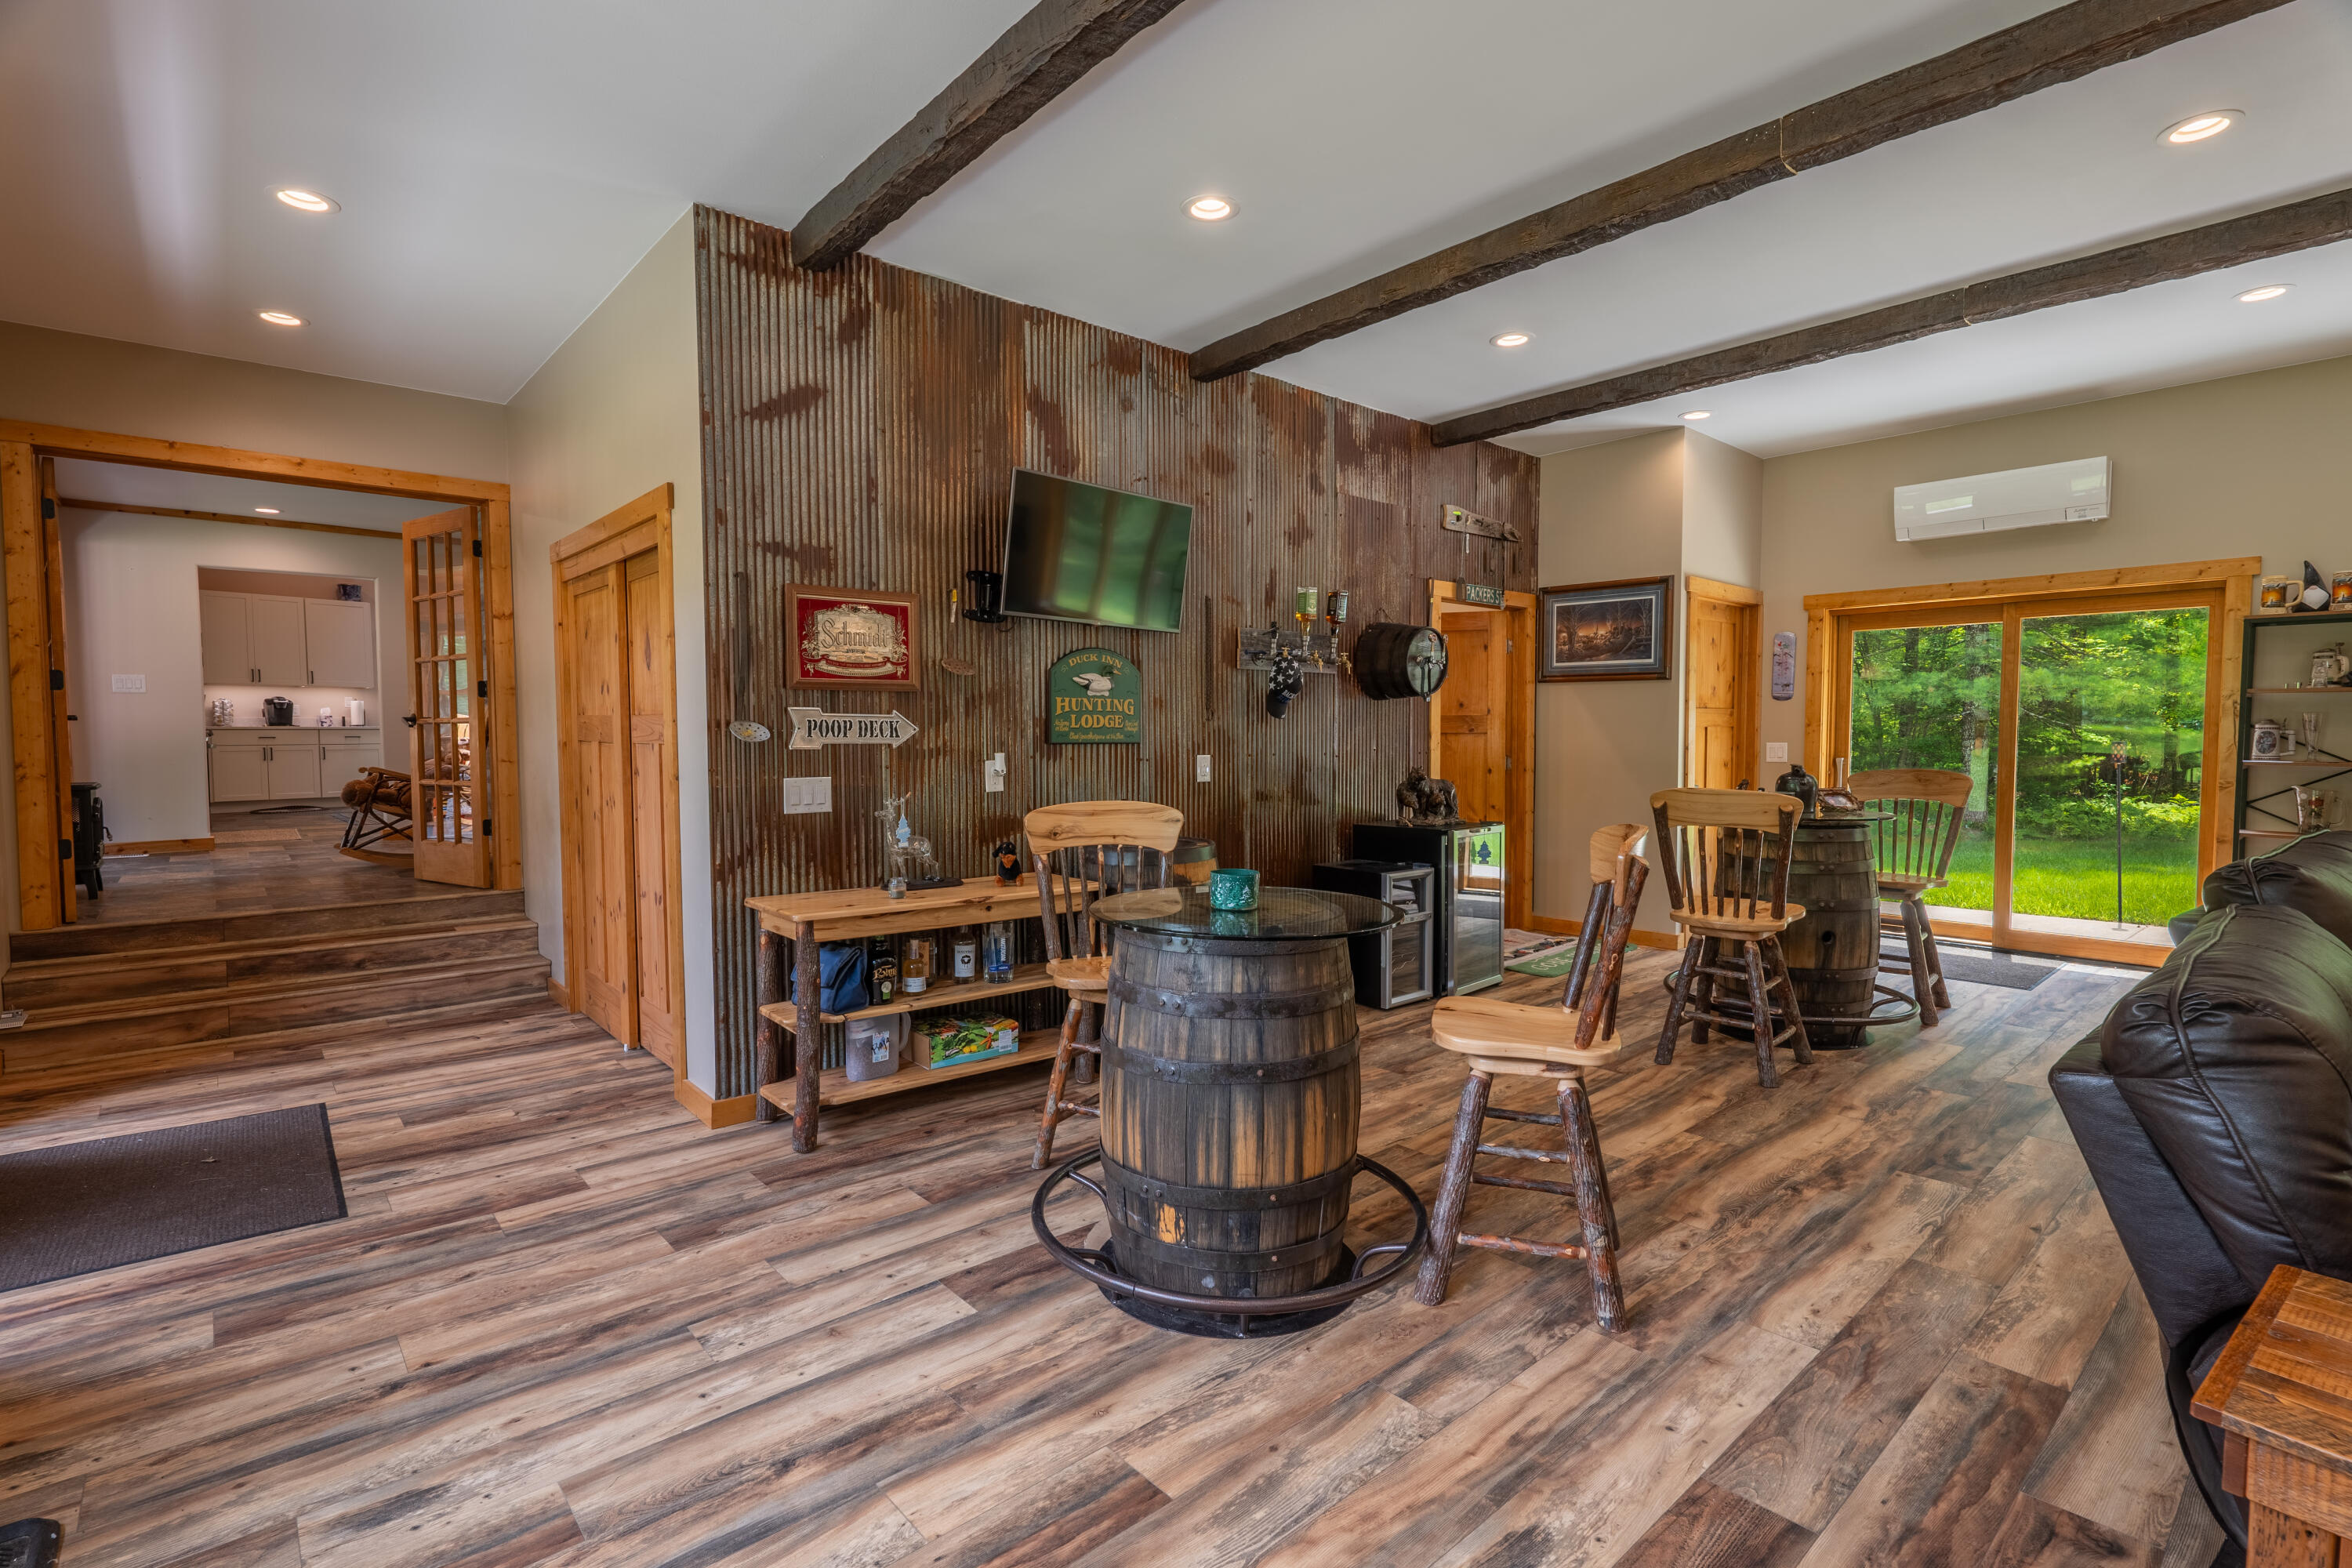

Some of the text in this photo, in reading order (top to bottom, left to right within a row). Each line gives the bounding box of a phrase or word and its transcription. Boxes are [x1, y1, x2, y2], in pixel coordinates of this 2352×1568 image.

[1466, 586, 1494, 603] PACKERS
[821, 618, 887, 648] Schmidt
[1069, 654, 1123, 668] DUCK INN
[1054, 696, 1134, 715] HUNTING
[807, 719, 901, 739] POOP DECK
[1070, 714, 1123, 728] LODGE
